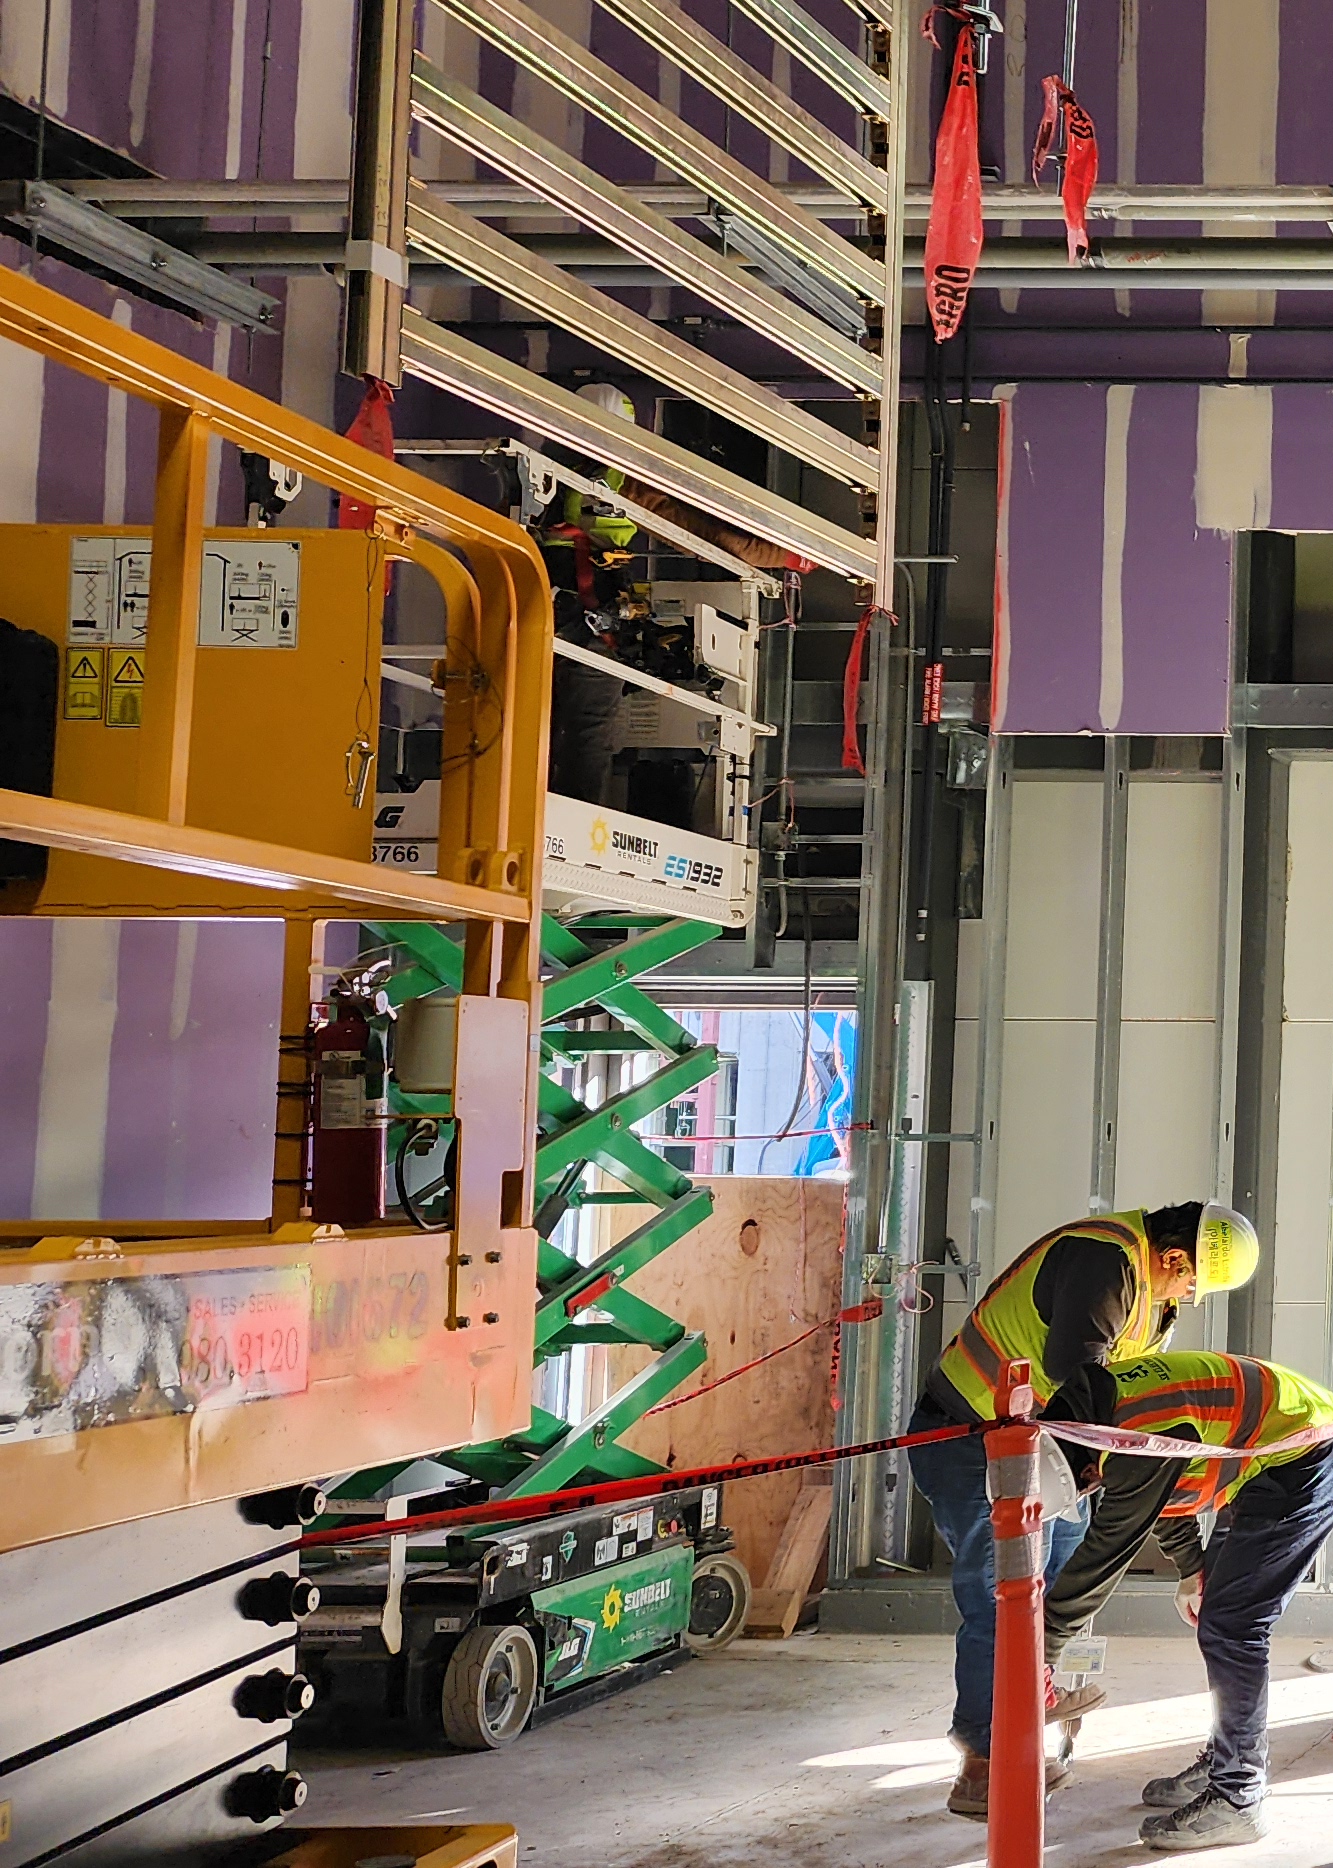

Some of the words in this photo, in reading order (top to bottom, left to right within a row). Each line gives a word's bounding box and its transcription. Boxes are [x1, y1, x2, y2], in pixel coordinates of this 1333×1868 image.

[544, 836, 565, 855] 766
[611, 830, 659, 859] SUNBELT
[617, 850, 652, 866] RENTALS
[664, 854, 724, 888] ES1932
